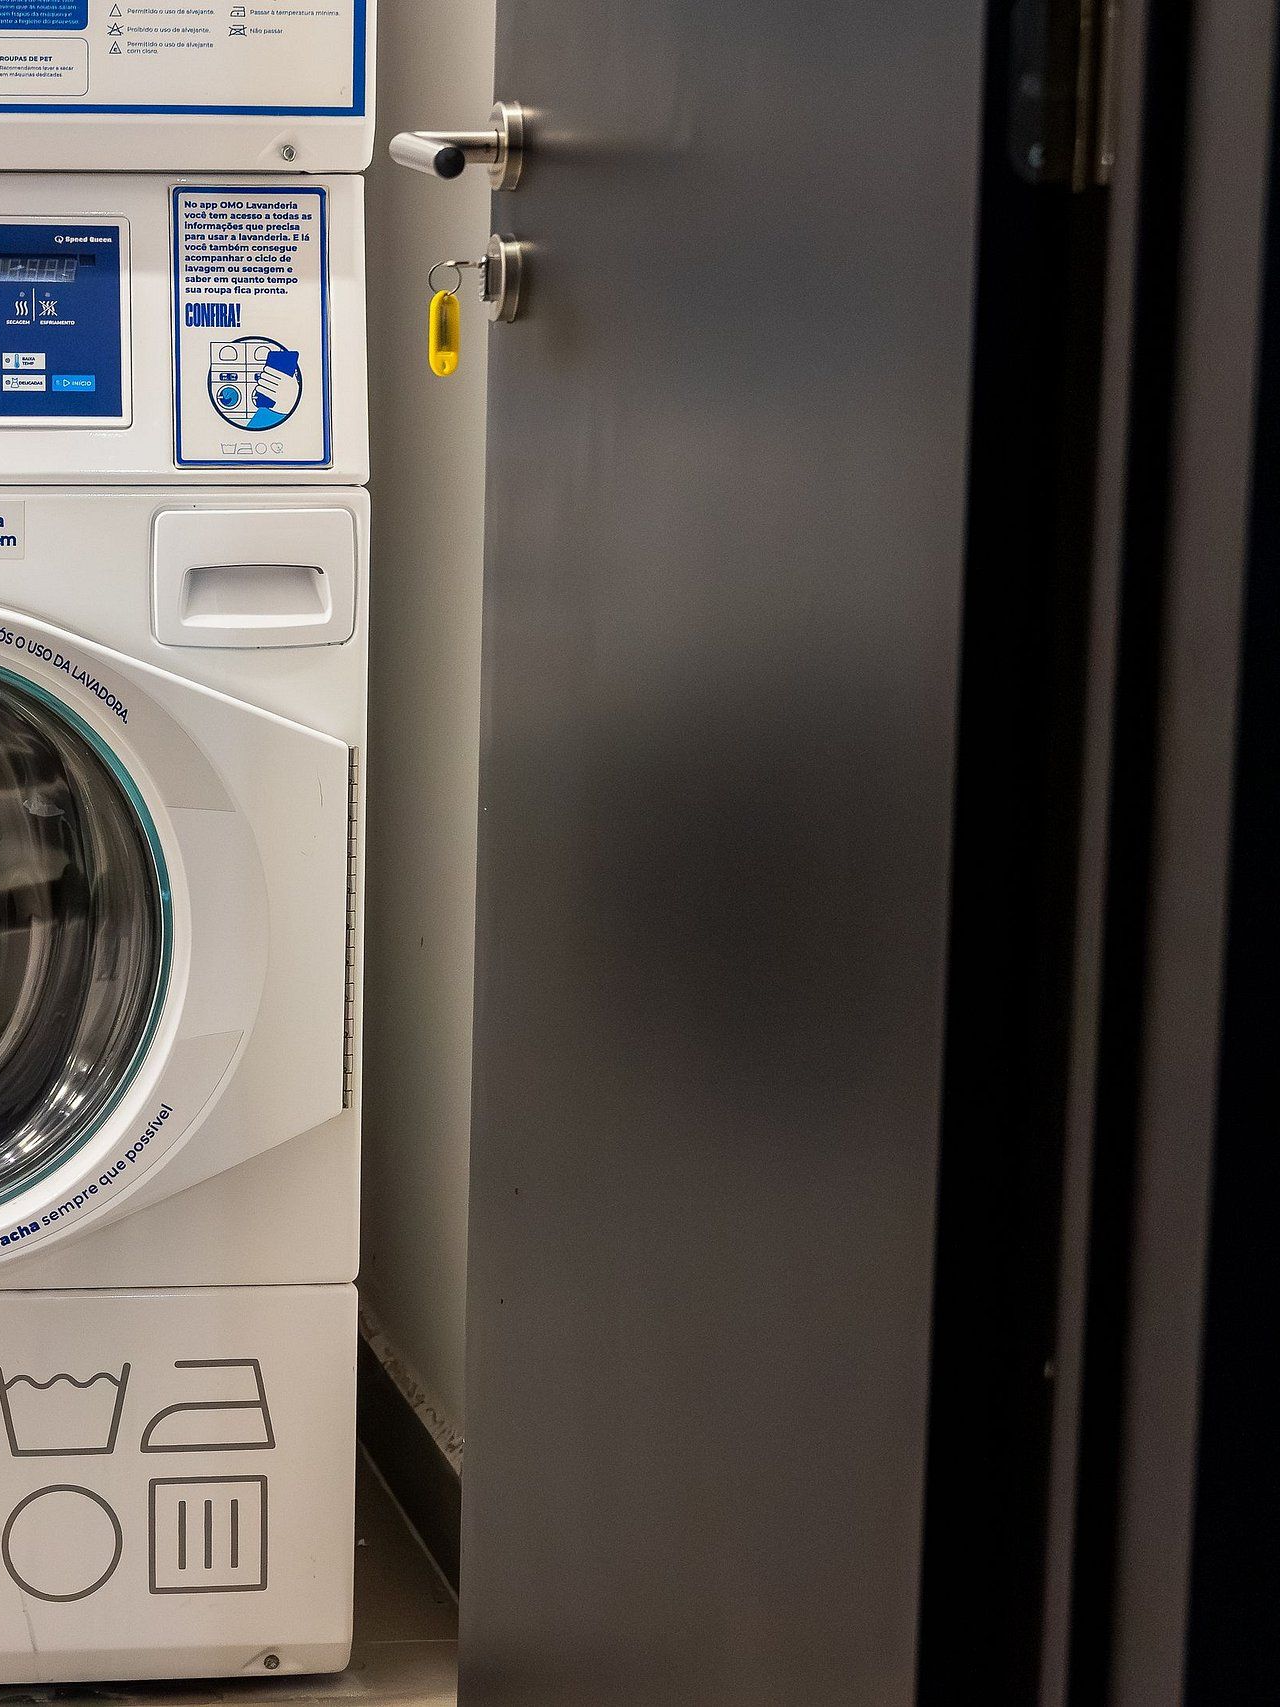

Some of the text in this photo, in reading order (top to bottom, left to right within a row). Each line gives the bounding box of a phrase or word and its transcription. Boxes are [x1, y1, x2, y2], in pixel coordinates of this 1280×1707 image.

[185, 222, 243, 231] informações
[266, 224, 300, 232] precisa
[239, 233, 290, 241] lavanderia.
[301, 233, 309, 241] lá
[252, 245, 297, 253] consegue
[185, 255, 244, 263] acompanhar
[185, 265, 225, 273] lavagem
[231, 277, 264, 285] quanto
[267, 277, 298, 285] tempo
[205, 287, 231, 295] roupa
[234, 286, 251, 294] fica
[254, 287, 288, 295] pronta.
[185, 303, 241, 328] CONFIRA!
[15, 637, 25, 649] O
[27, 640, 53, 662] USO
[53, 654, 71, 674] DA
[71, 665, 128, 724] LAVADORA.
[41, 1184, 99, 1226] sempre
[98, 1160, 127, 1186] que
[125, 1103, 173, 1164] possível
